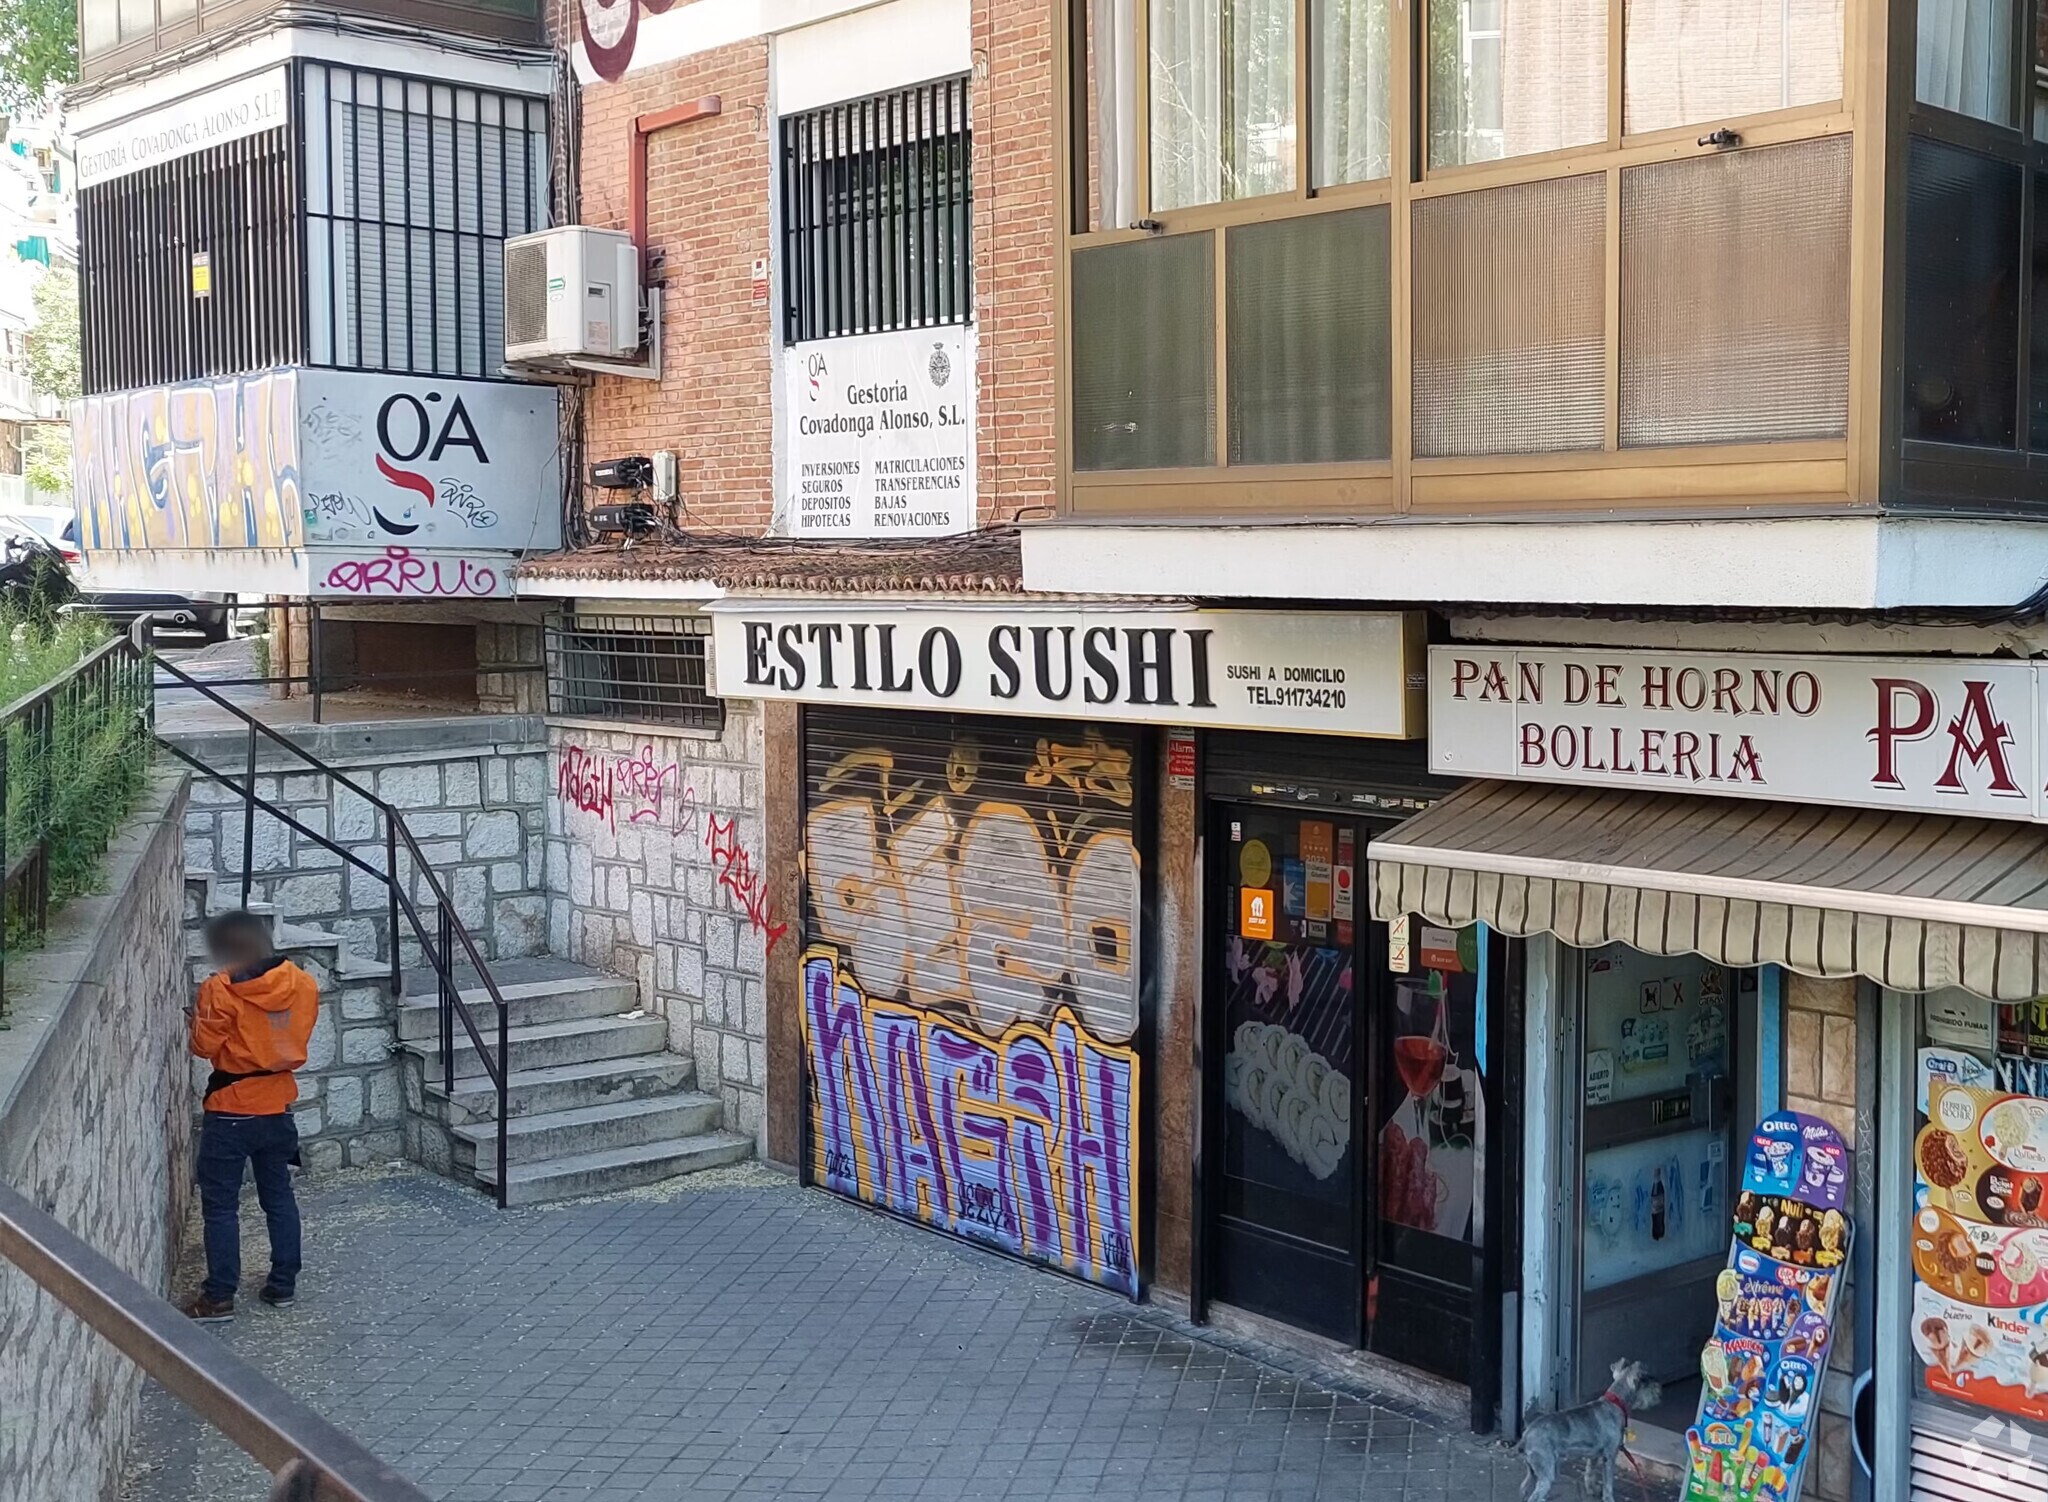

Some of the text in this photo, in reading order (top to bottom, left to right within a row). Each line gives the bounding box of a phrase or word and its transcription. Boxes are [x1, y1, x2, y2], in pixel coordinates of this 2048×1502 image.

[131, 123, 199, 160] COVADONGA
[202, 104, 249, 140] ALONSO
[800, 404, 966, 438] Covadonga Alonso, S.L.
[801, 461, 860, 477] INVERSIONES
[874, 456, 965, 475] MATRICULACIONES
[801, 479, 843, 494] SEGUROS
[875, 475, 961, 492] TRANSFERENCIAS
[801, 496, 851, 511] DEPOSITOS
[874, 495, 907, 509] BAJAS
[801, 513, 851, 528] HIPOTECAS
[874, 511, 950, 527] RENOVACIONES
[741, 621, 962, 698] ESTILO
[988, 624, 1217, 708] SUSHI
[1227, 665, 1346, 683] SUSHI A DOMICILIO
[1451, 659, 1822, 717] PAN DE HORNO
[1247, 686, 1346, 709] TEL.911734210
[1865, 678, 2048, 799] PA
[1519, 722, 1768, 785] BOLLERIA
[1964, 1020, 1989, 1031] FUMAR
[1762, 1121, 1798, 1133] OREO
[1803, 1126, 1828, 1140] Milka
[1943, 1309, 1972, 1321] bueno
